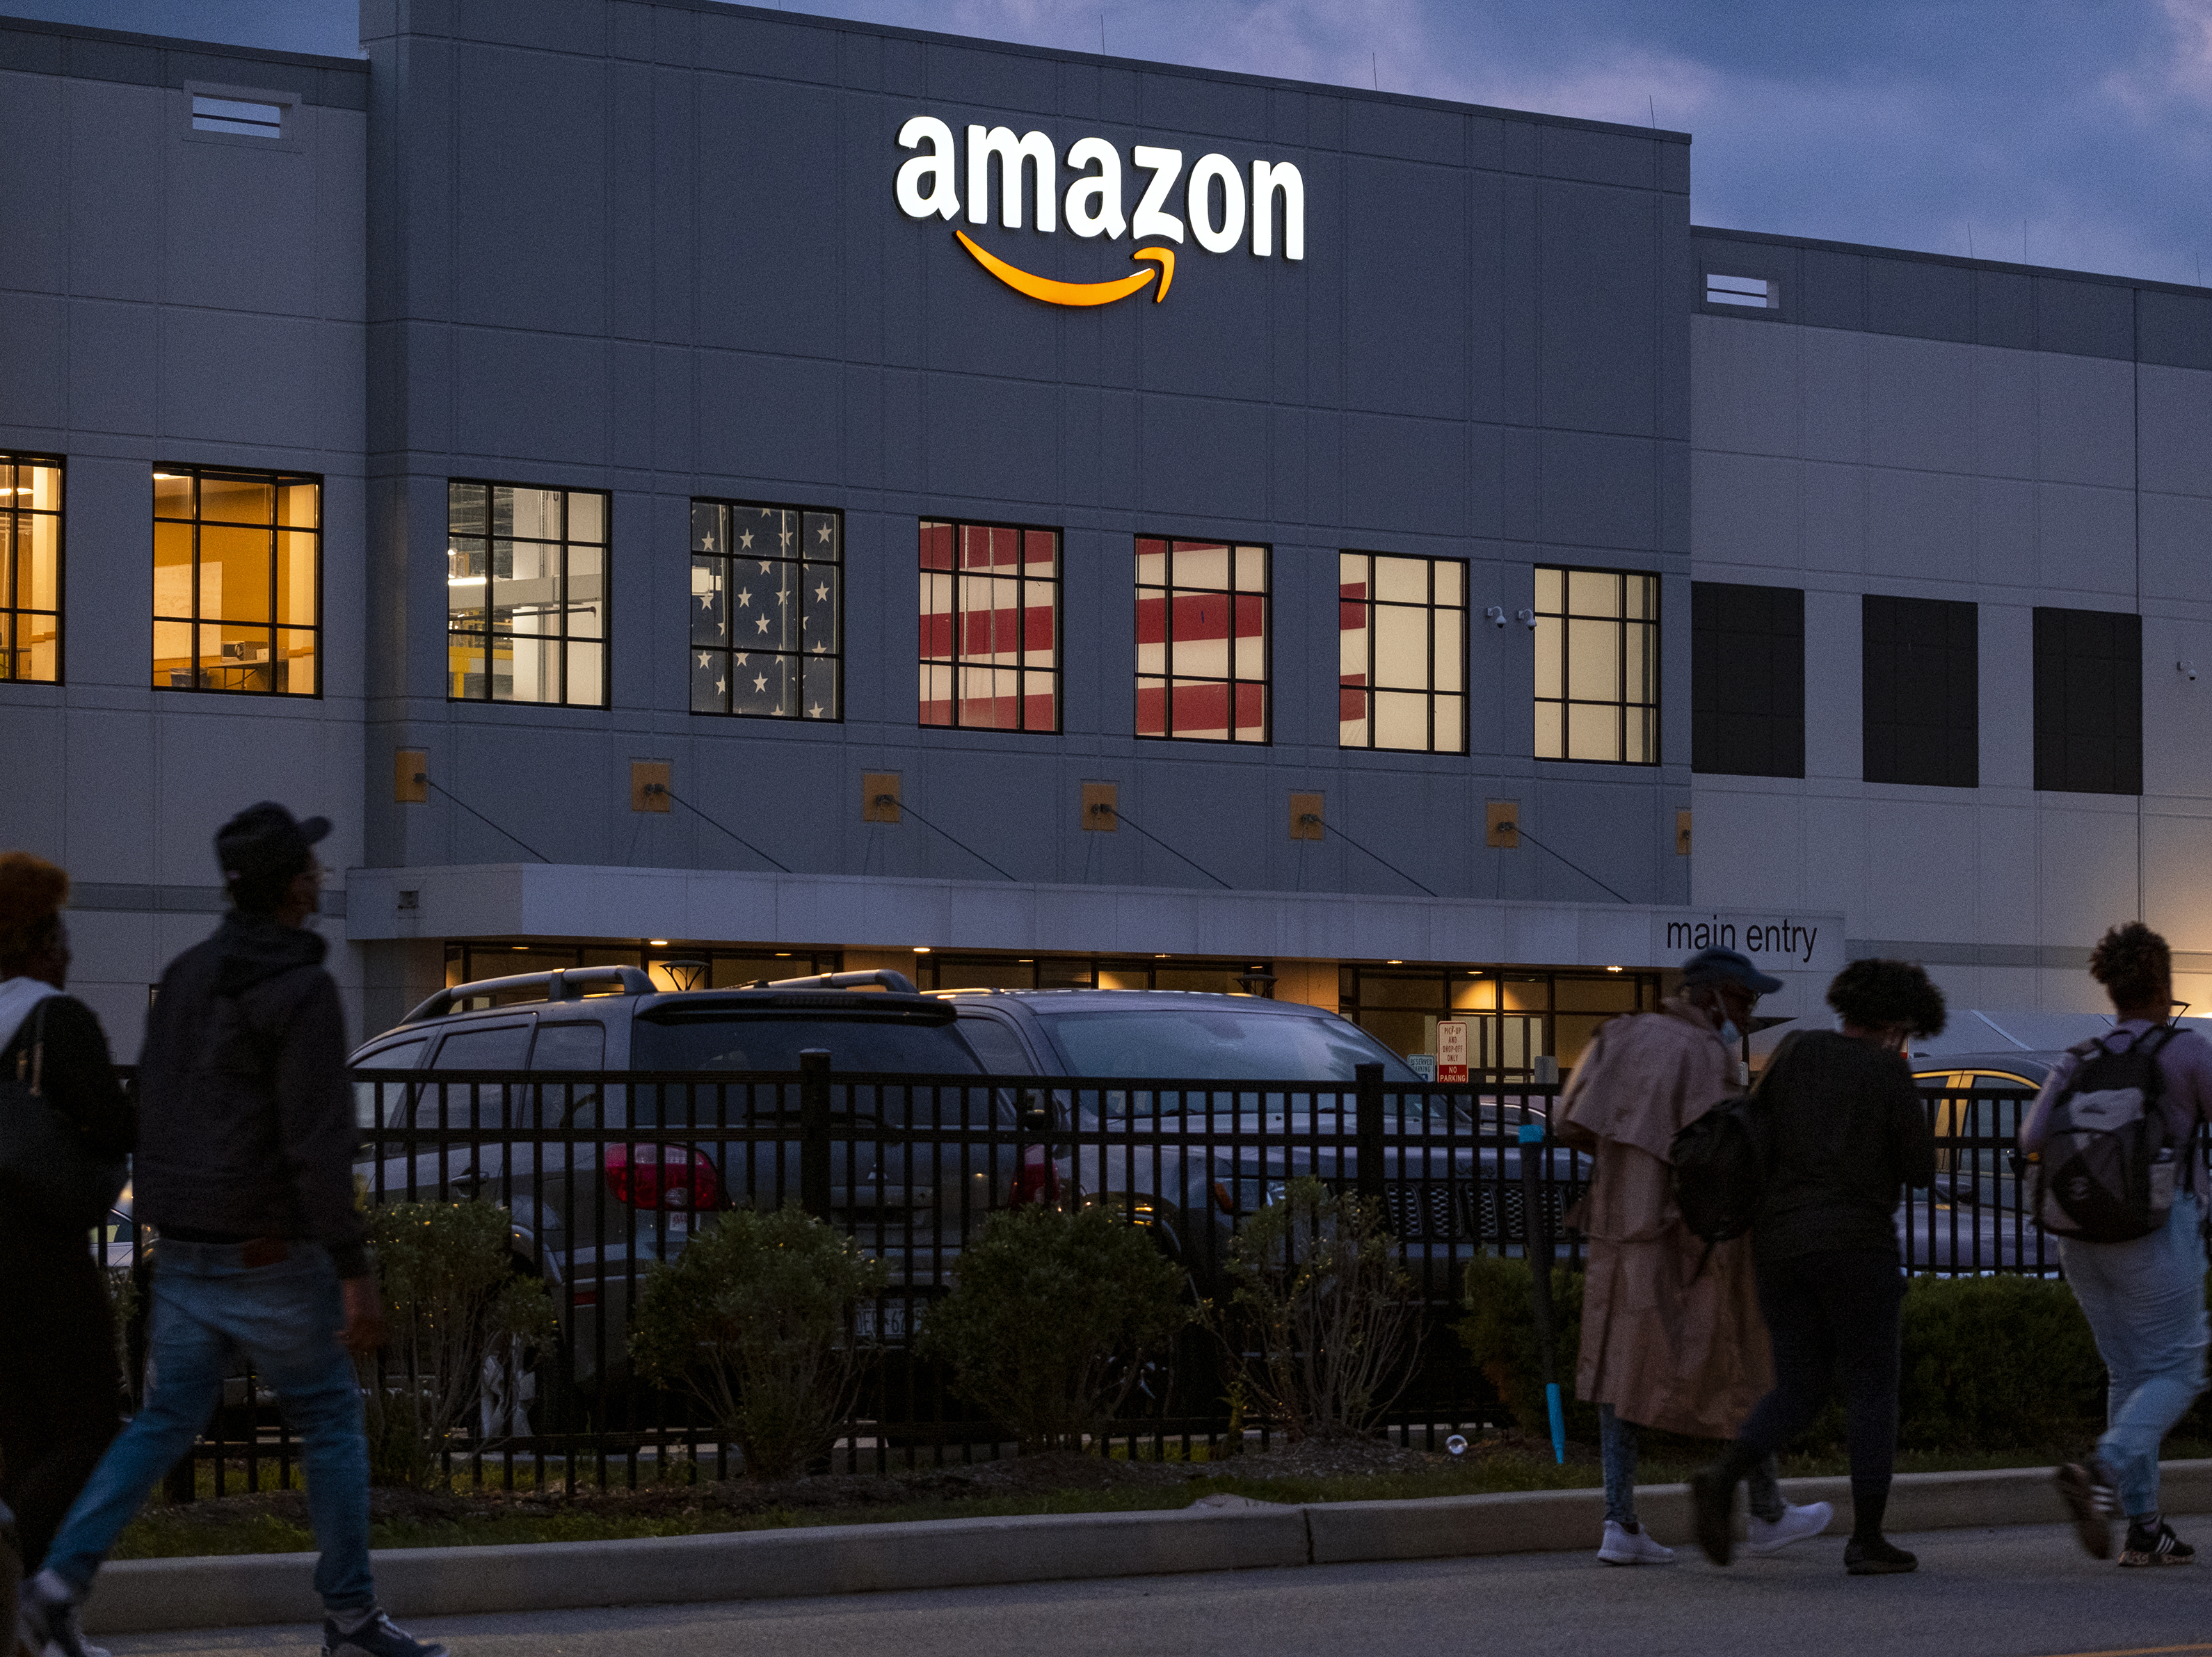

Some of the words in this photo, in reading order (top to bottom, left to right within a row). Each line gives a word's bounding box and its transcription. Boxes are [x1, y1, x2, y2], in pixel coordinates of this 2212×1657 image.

[895, 115, 1304, 261] amazon
[1667, 914, 1736, 950] main
[1747, 918, 1817, 963] entry
[1444, 1026, 1461, 1034] PICK-UP
